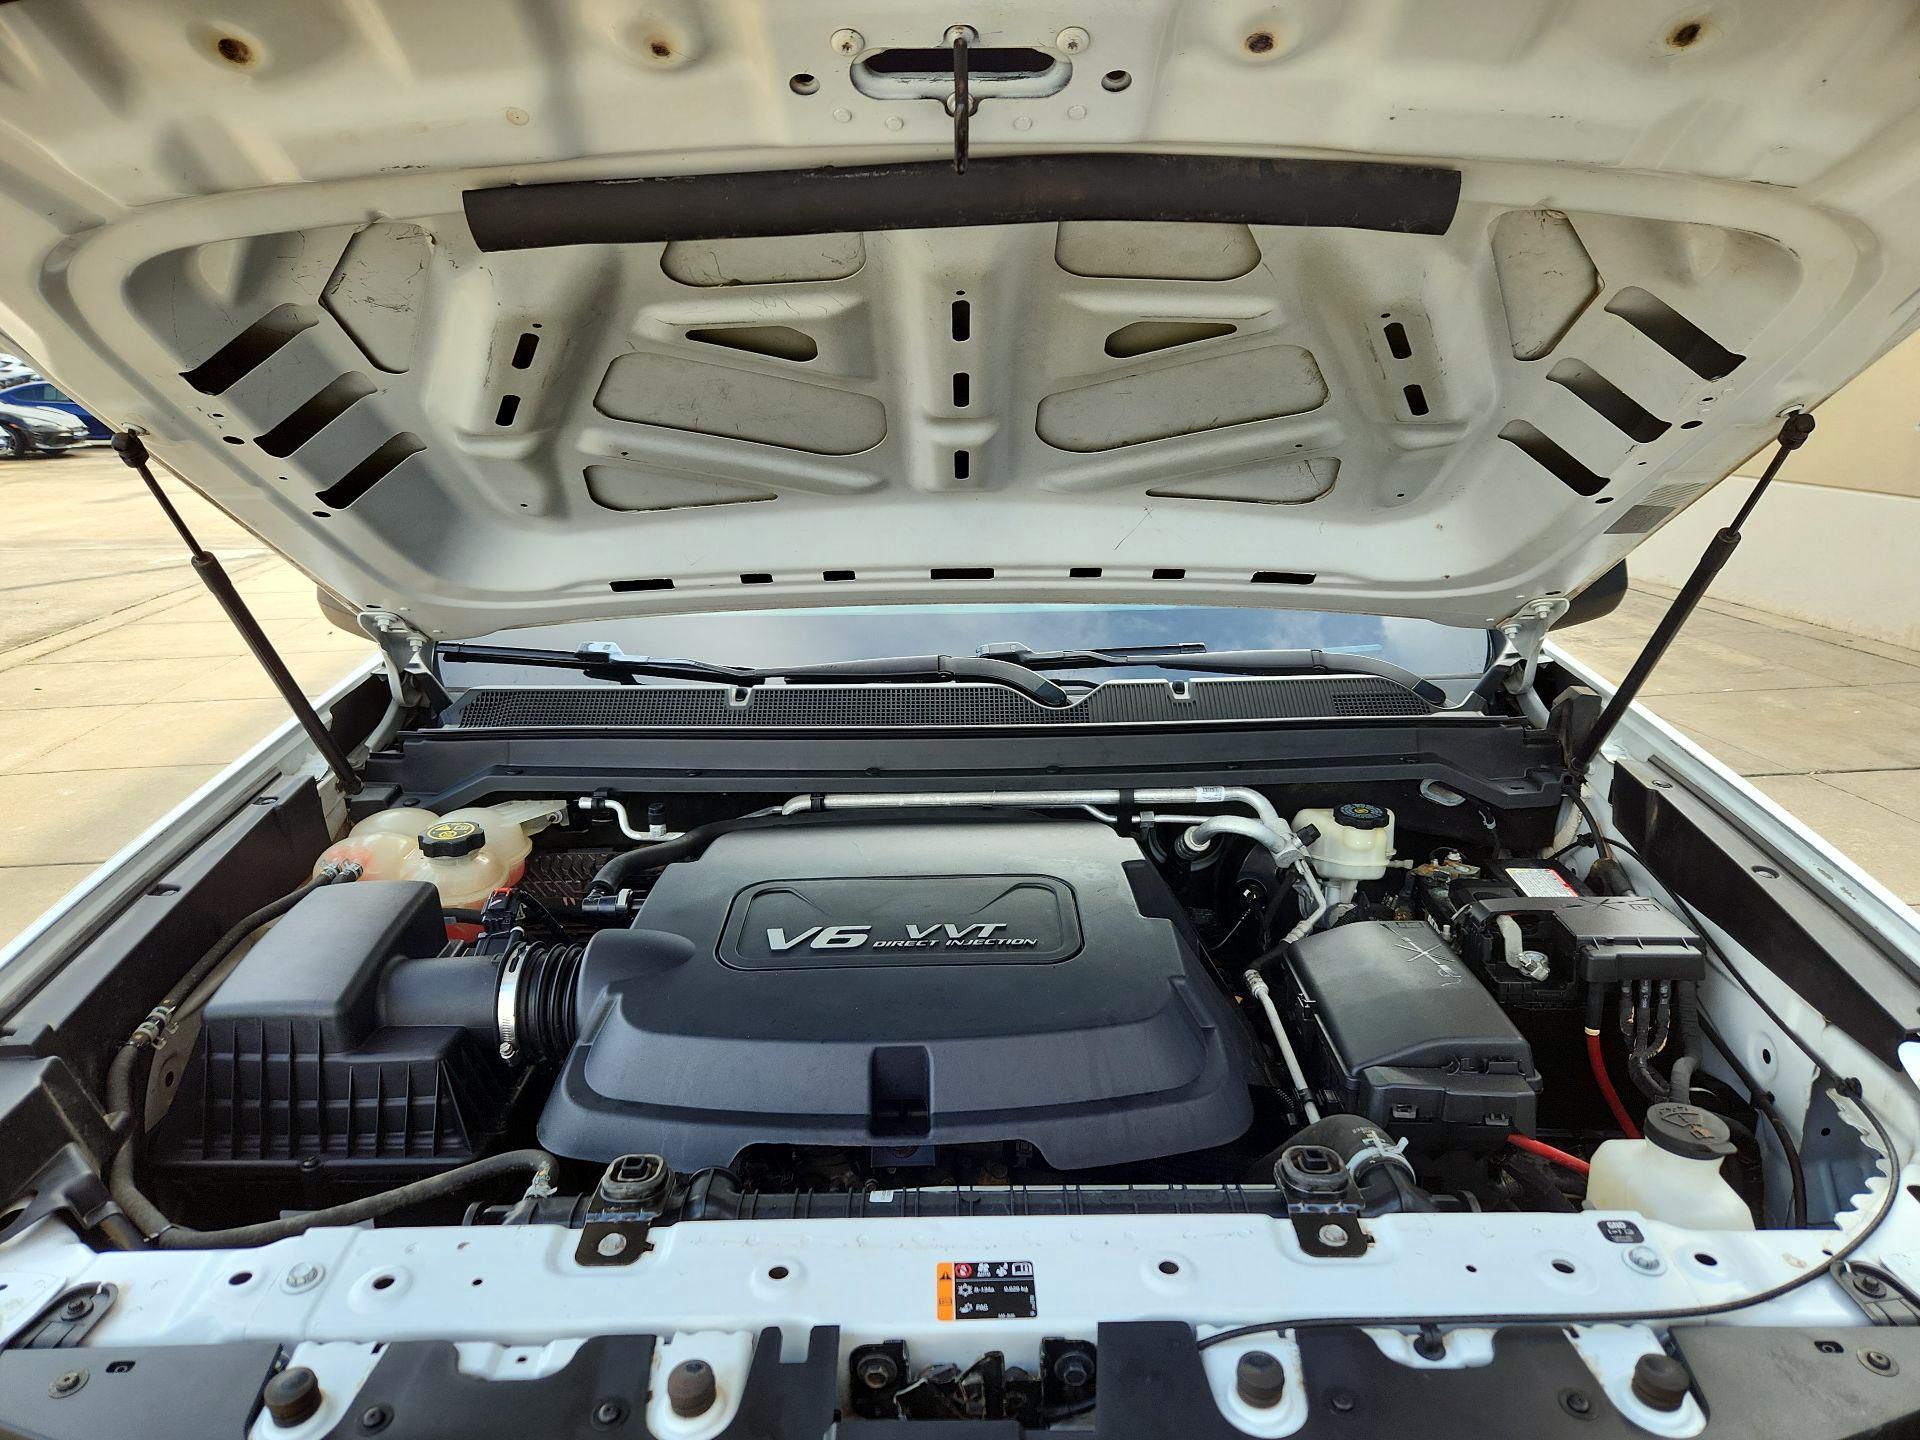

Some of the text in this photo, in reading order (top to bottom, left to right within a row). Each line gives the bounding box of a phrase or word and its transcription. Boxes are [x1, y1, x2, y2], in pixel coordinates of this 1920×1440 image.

[766, 925, 872, 951] V6
[905, 923, 1007, 939] VVT
[872, 937, 1038, 948] DIRECT INJECTION
